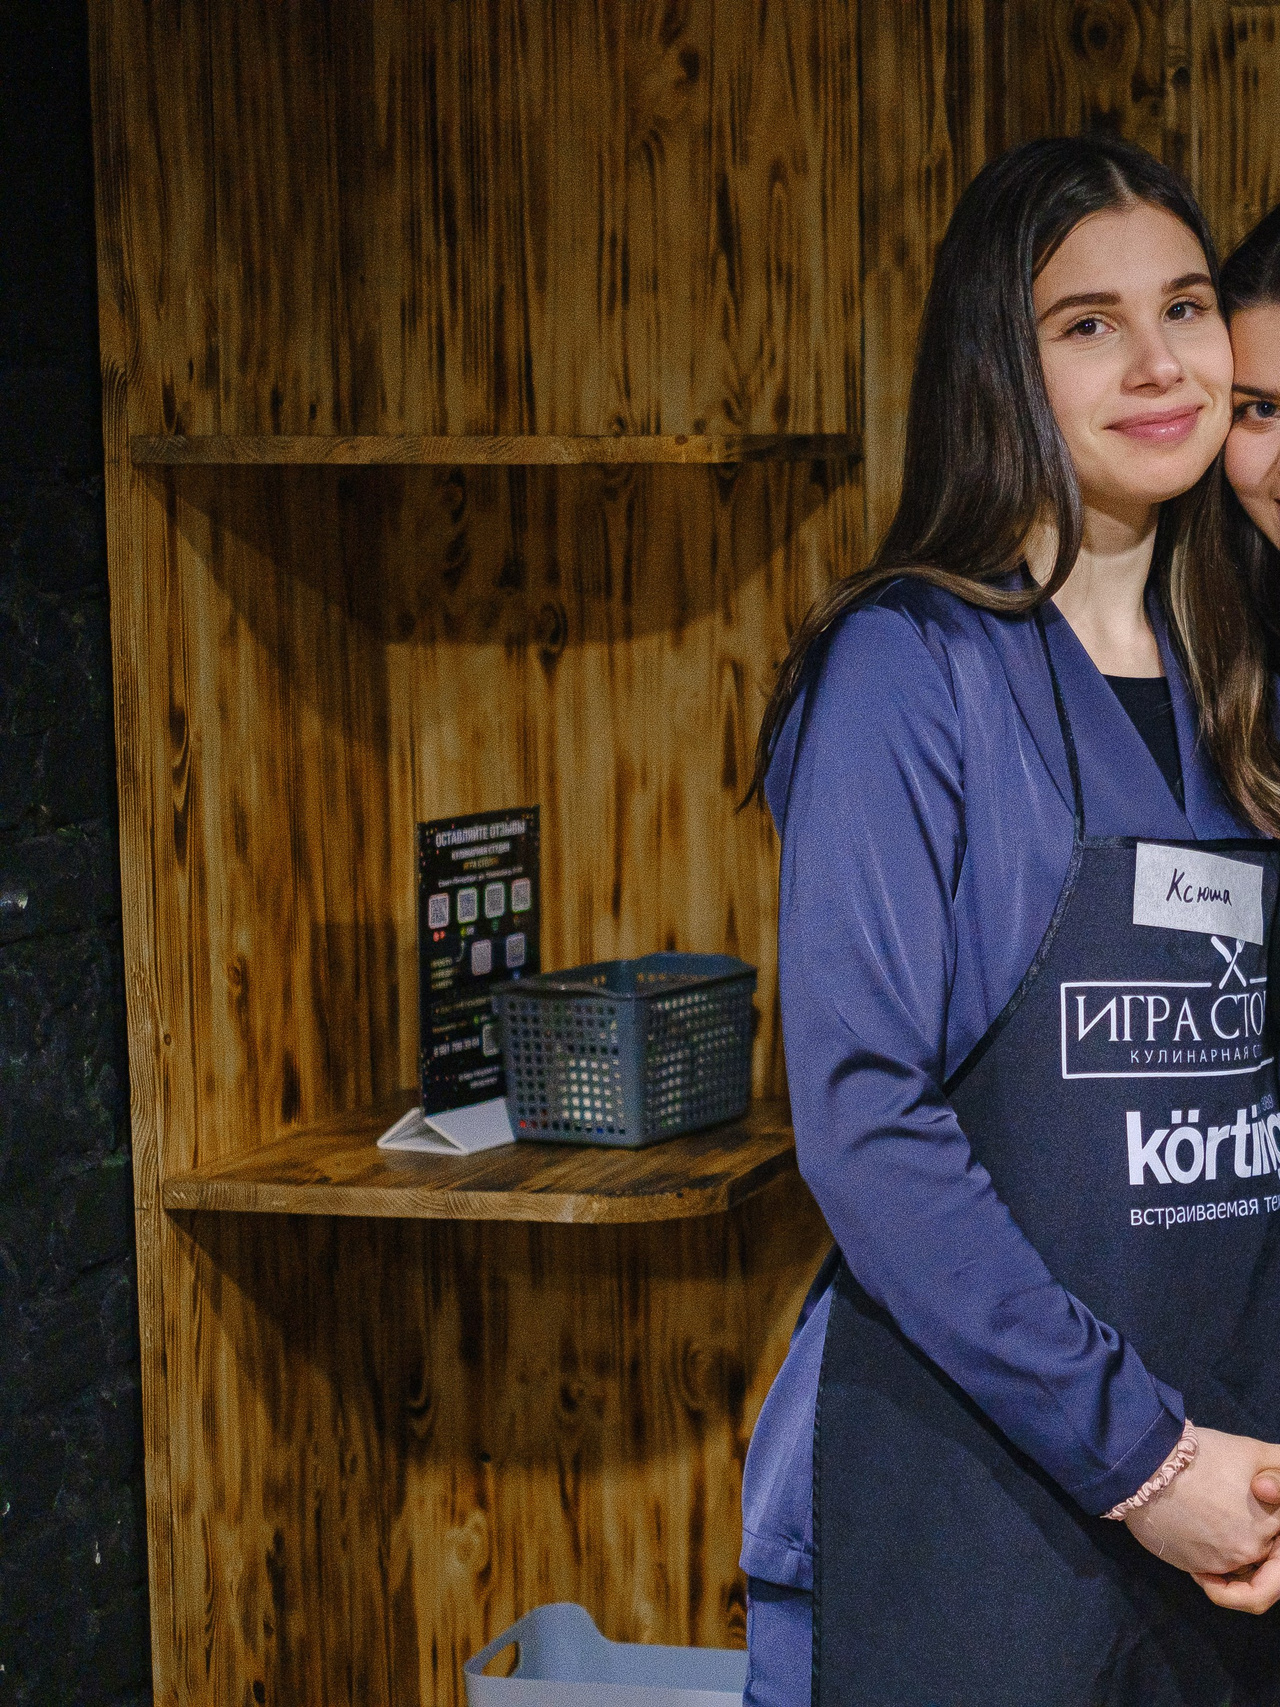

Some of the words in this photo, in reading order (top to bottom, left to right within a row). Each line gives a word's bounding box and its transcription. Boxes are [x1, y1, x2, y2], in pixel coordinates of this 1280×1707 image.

[1166, 868, 1232, 906] Ксюша
[1076, 994, 1202, 1042] ИГРА
[1130, 1045, 1249, 1064] КУЛИНАРНАЯ
[1130, 1197, 1259, 1230] встраиваемая
